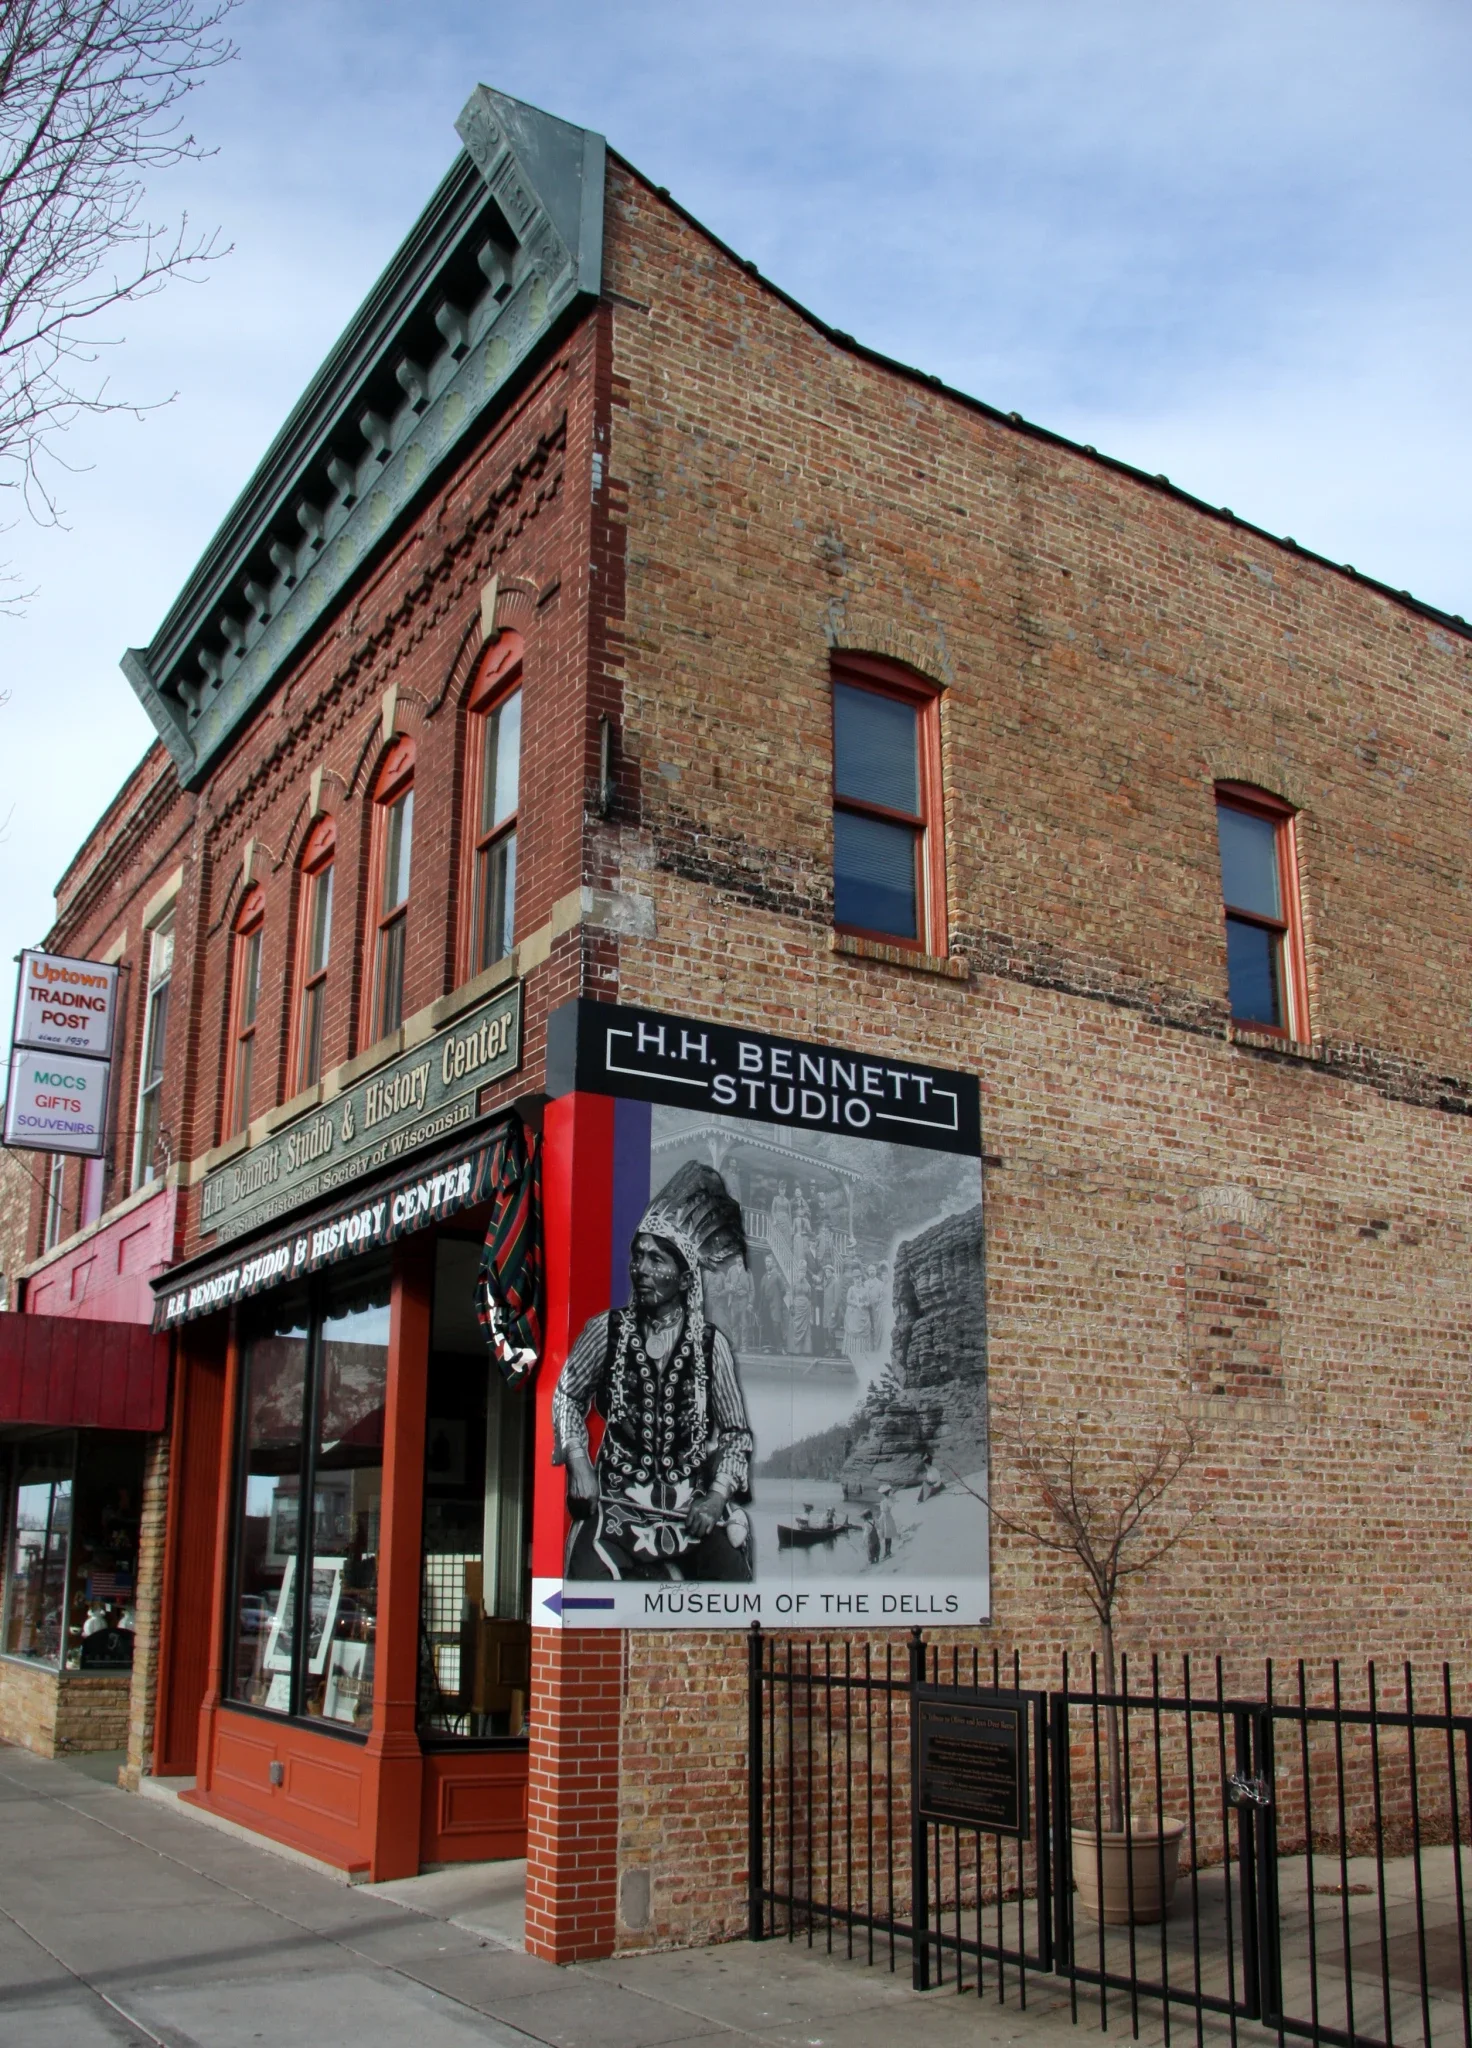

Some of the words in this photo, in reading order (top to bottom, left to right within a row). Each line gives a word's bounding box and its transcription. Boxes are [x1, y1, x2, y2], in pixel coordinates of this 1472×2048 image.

[32, 961, 109, 989] Uptown
[29, 987, 107, 1012] TRADING
[41, 1011, 90, 1030] POST
[37, 1033, 62, 1043] since
[65, 1036, 90, 1046] 1939
[636, 1021, 718, 1066] H.H.
[738, 1041, 934, 1105] BENNETT
[34, 1071, 87, 1090] MOCS
[35, 1094, 81, 1113] GIFTS
[711, 1074, 872, 1128] STUDIO
[17, 1115, 95, 1135] SOUVENIRS
[202, 1177, 226, 1220] H.H.
[231, 1144, 280, 1204] Bennett
[286, 1116, 333, 1174] Studio
[341, 1100, 354, 1142] &
[364, 1060, 431, 1129] History
[442, 1011, 512, 1085] Center
[219, 1225, 237, 1242] The
[237, 1211, 263, 1233] State
[266, 1179, 320, 1219] Historical
[323, 1156, 369, 1190] Society
[372, 1142, 388, 1166] of
[390, 1104, 471, 1156] Wisconsin
[166, 1293, 186, 1319] H.H.
[188, 1269, 240, 1311] BENNETT
[240, 1246, 290, 1289] STUDIO
[293, 1239, 307, 1266] &
[311, 1202, 386, 1260] HISTORY
[392, 1162, 471, 1225] CENTER
[644, 1593, 761, 1613] MUSEUM
[776, 1594, 809, 1613] OF
[820, 1594, 869, 1613] THE
[882, 1594, 959, 1613] DELLS
